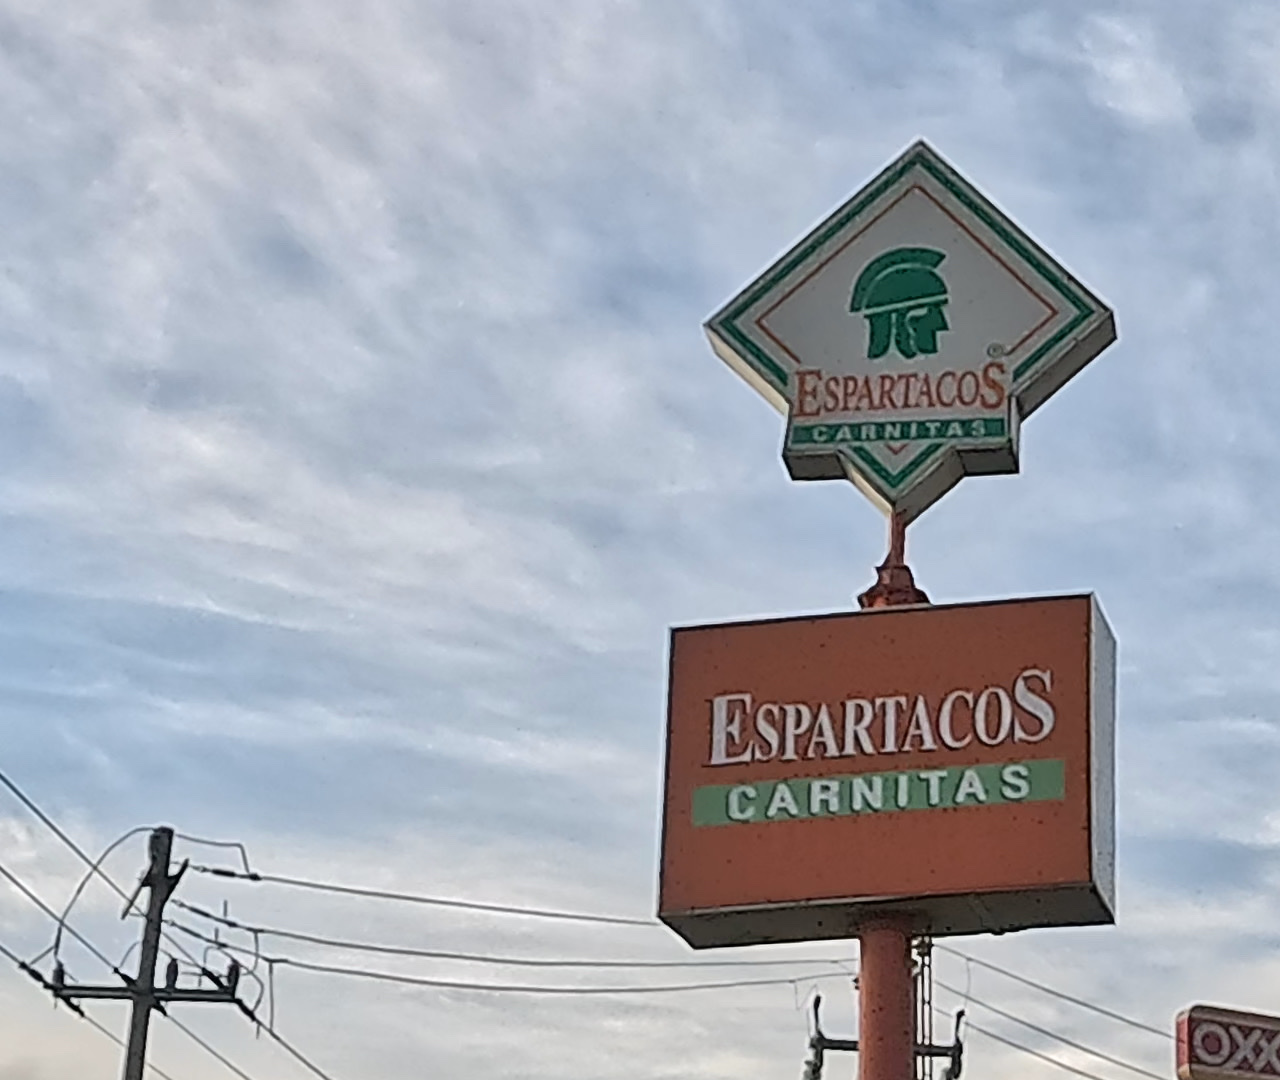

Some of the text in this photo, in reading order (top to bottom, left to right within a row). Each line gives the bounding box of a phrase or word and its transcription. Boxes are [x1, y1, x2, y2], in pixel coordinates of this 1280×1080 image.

[793, 361, 1006, 417] ESPARTACOS
[811, 420, 987, 442] CARNITAS
[704, 668, 1055, 766] ESPARTACOS
[727, 764, 1030, 821] CARNITAS
